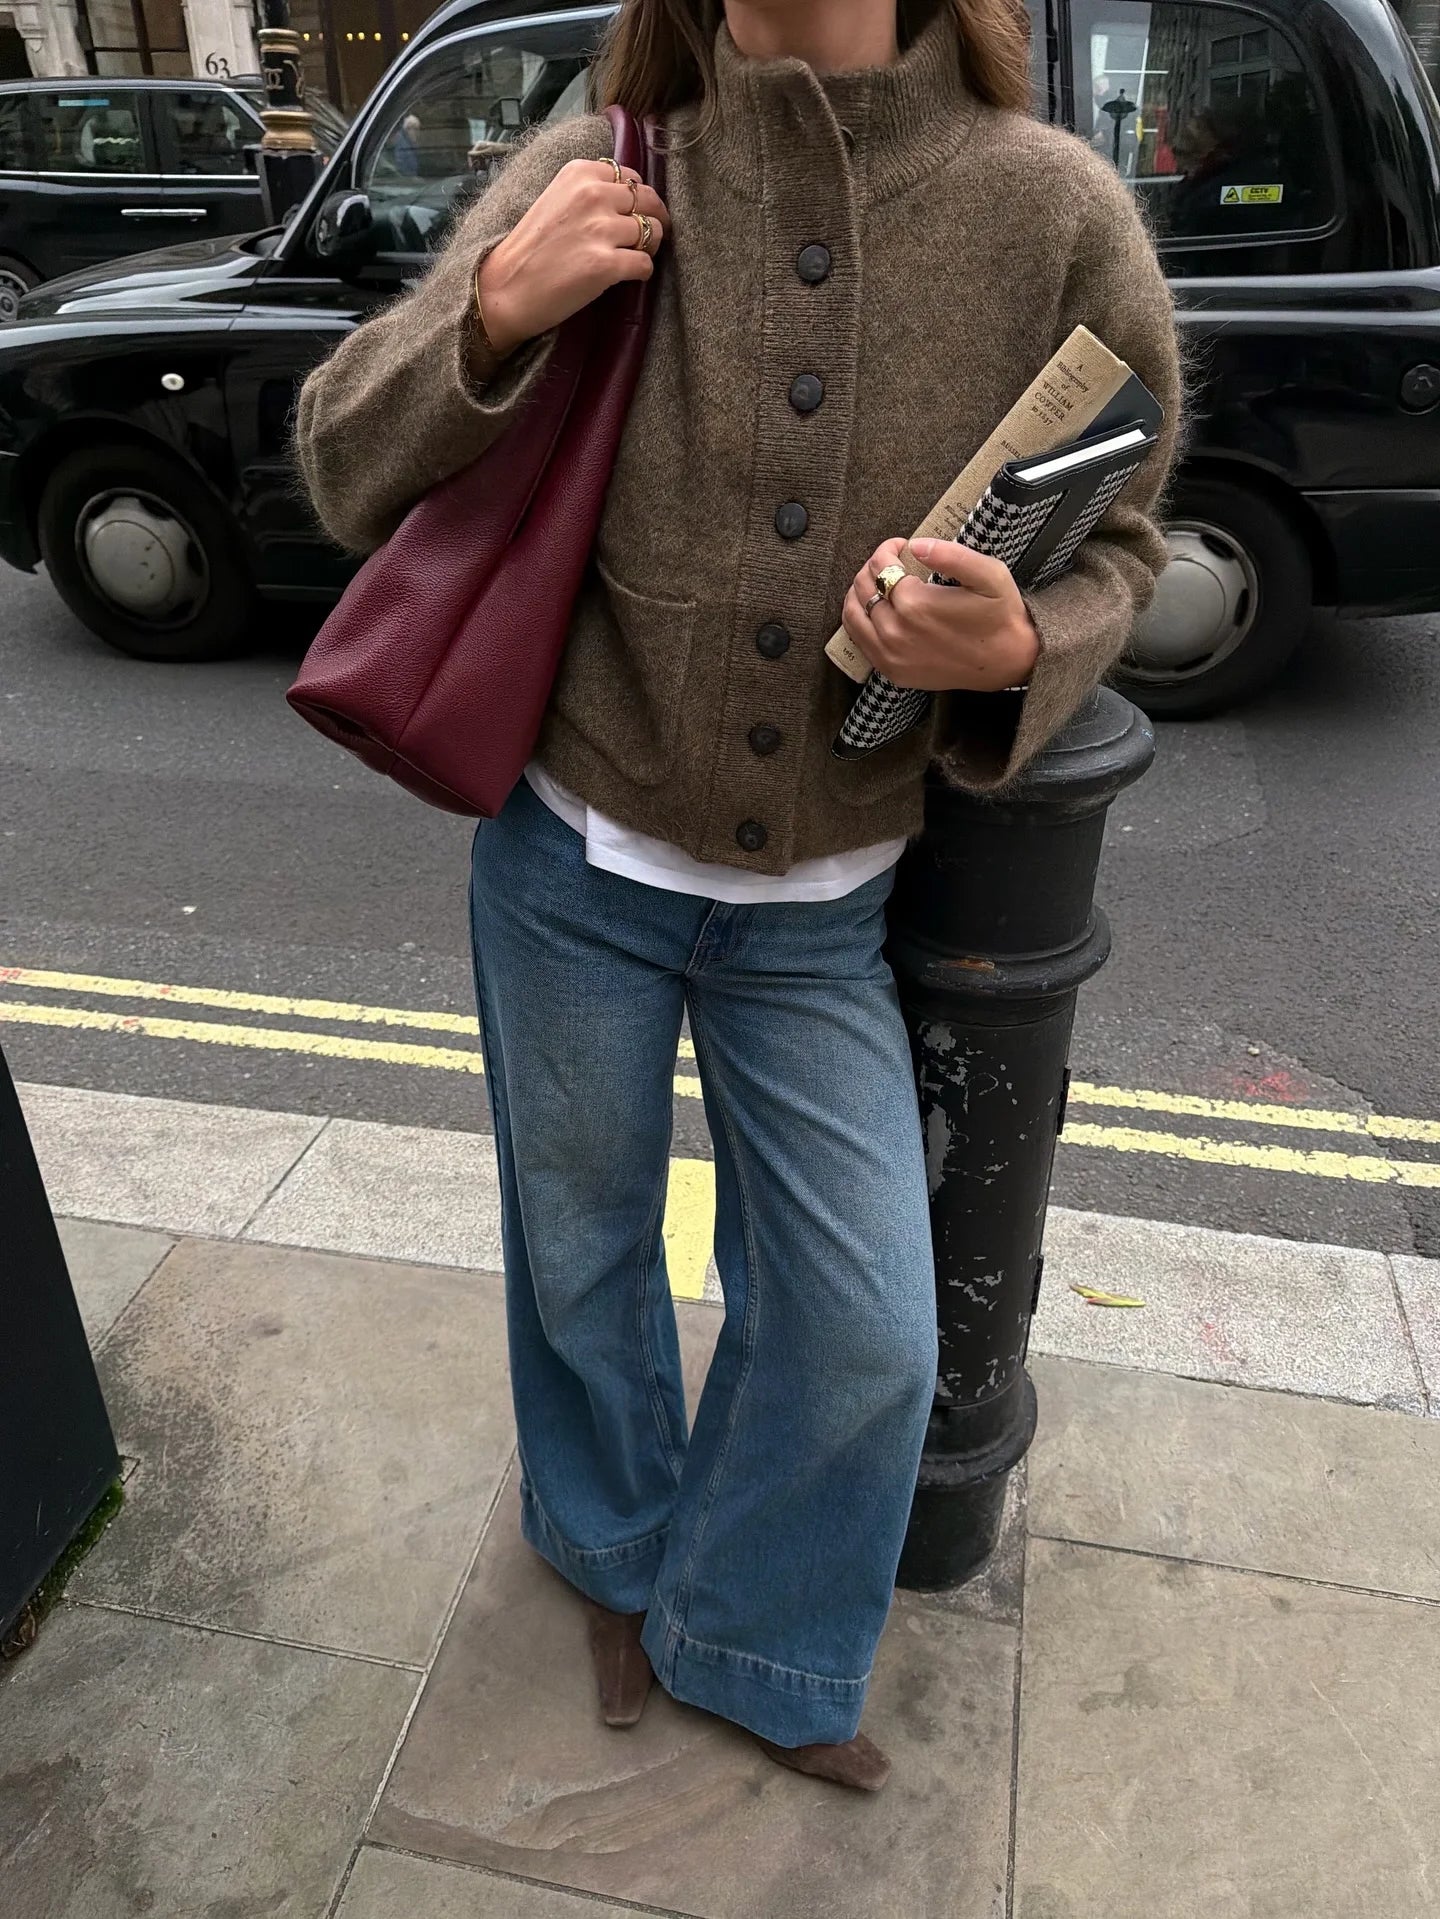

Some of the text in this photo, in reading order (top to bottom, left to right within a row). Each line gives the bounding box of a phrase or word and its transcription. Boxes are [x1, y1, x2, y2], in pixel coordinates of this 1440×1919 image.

[205, 51, 232, 79] 63
[1057, 361, 1089, 393] Bibliography
[1076, 364, 1085, 372] A
[1042, 381, 1075, 412] WILLIAM
[1061, 383, 1070, 391] of
[1034, 391, 1066, 421] COWPER
